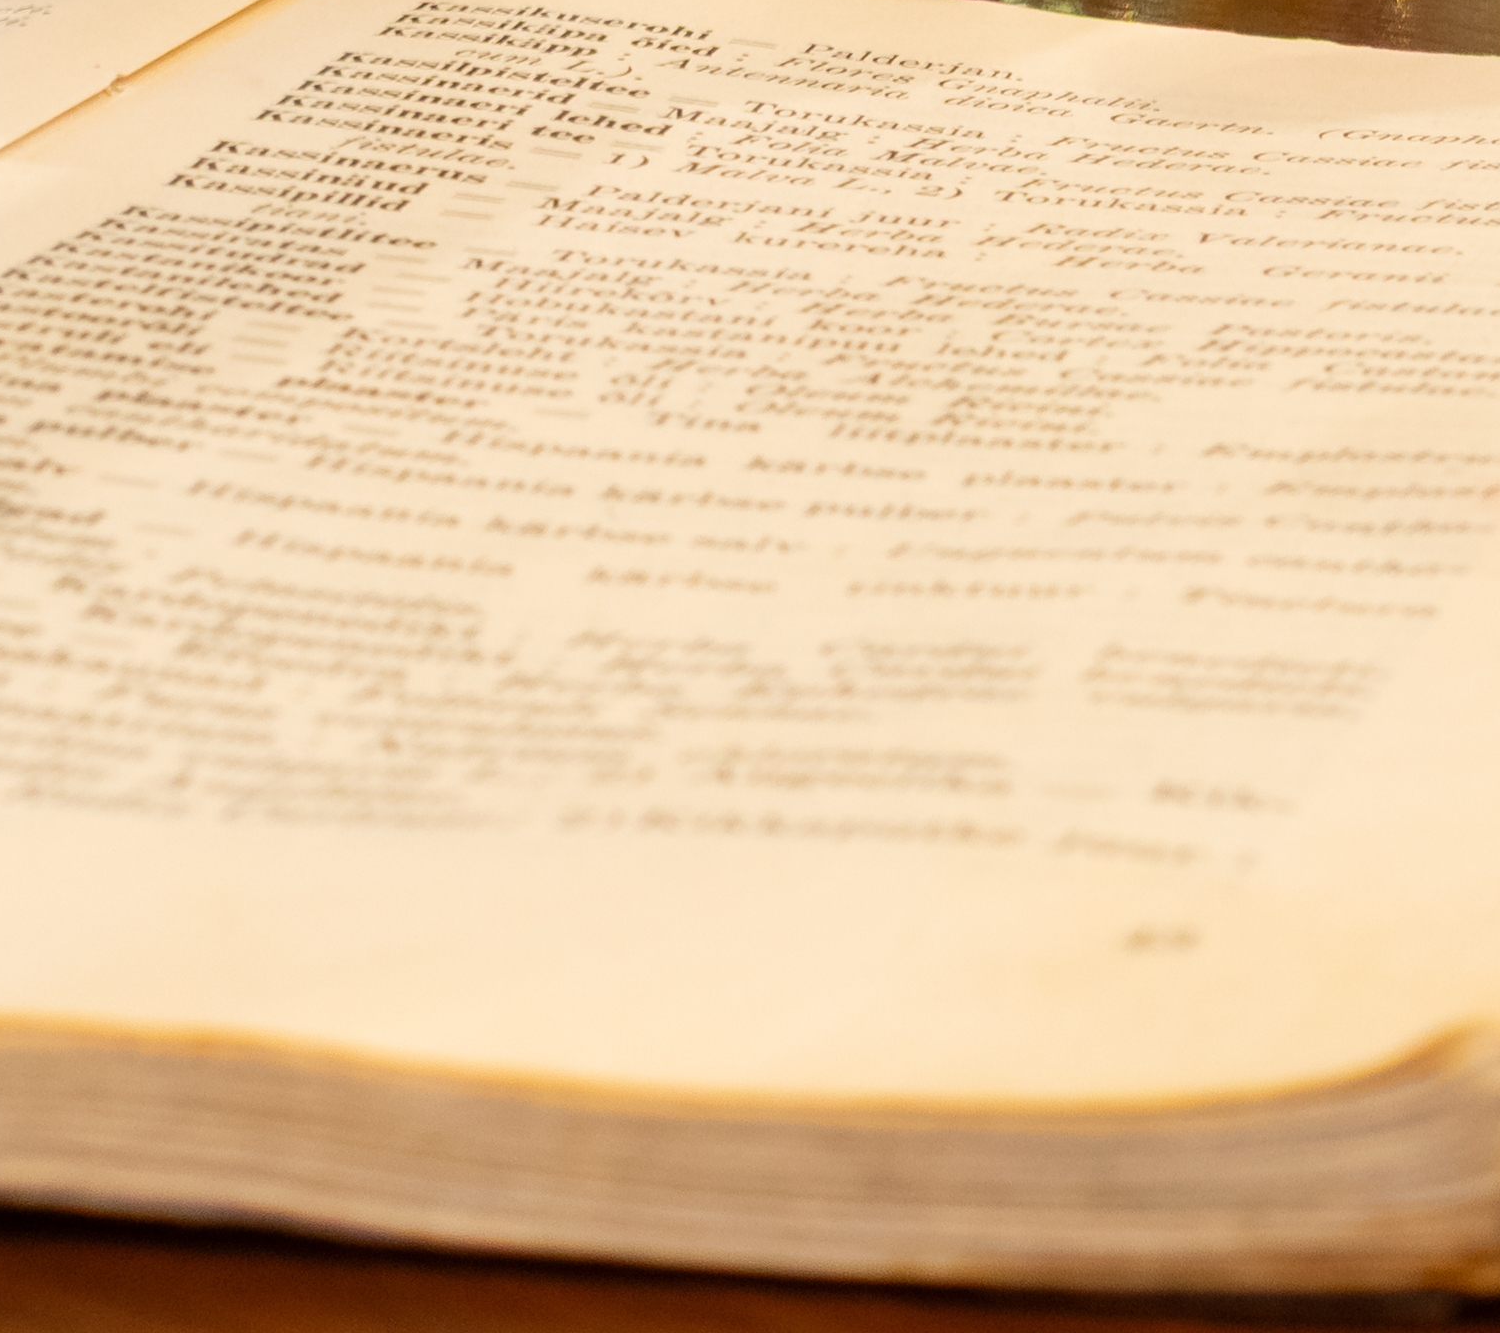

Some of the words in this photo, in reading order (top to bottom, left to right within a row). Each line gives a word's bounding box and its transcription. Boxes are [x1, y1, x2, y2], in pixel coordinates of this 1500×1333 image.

[378, 26, 599, 56] Kassikäpp
[657, 58, 908, 99] Antennaria
[941, 95, 1074, 116] dioica
[1107, 113, 1271, 134] Gaertn.
[394, 14, 609, 42] Kassikäpa
[630, 36, 719, 56] õied
[777, 57, 916, 83] Flores
[935, 78, 1157, 111] Gnaphalii.
[414, 2, 716, 40] Kassikuserohi
[802, 43, 1021, 81] Palderjan.
[450, 49, 540, 65] cum
[275, 93, 513, 131] Kassinaeri
[530, 125, 596, 144] tee
[686, 144, 931, 181] Torukassia
[1021, 179, 1205, 199] Fructus
[1223, 191, 1400, 208] Cassiae
[296, 80, 533, 116] Kassinaeri
[555, 108, 674, 135] lehed
[731, 134, 848, 157] Folia
[870, 150, 1044, 175] Malvae.
[316, 65, 576, 104] Kassinaerid
[659, 106, 848, 141] Maajalg
[906, 137, 1049, 160] Herba
[1070, 154, 1269, 175] Hederae.
[332, 135, 515, 169] fistulae.
[335, 51, 653, 97] Kassilpisteltee
[750, 100, 987, 138] Torukassia
[1050, 136, 1228, 158] Fructus
[1249, 151, 1422, 168] Cassiae
[190, 156, 433, 194] Kassinäud
[534, 196, 734, 226] Maajalg
[794, 222, 944, 242] Herba
[975, 235, 1182, 258] Hederae.
[209, 139, 491, 183] Kassinaerus
[585, 185, 834, 218] Palderjani
[850, 213, 962, 227] juur
[1025, 223, 1170, 241] Radix
[1198, 232, 1463, 254] Valerianae.
[254, 109, 516, 149] Kassinaeris
[608, 152, 648, 168] 1)
[670, 160, 817, 185] Malva
[914, 185, 974, 199] 2)
[998, 190, 1248, 216] Torukassia
[166, 172, 413, 211] Kassipillid
[535, 214, 695, 237] Haisev
[730, 231, 942, 258] kurereha
[1053, 256, 1202, 274] Herba
[1260, 264, 1451, 284] Geranii
[461, 257, 659, 286] Maajalg
[552, 249, 813, 280] Torukassia
